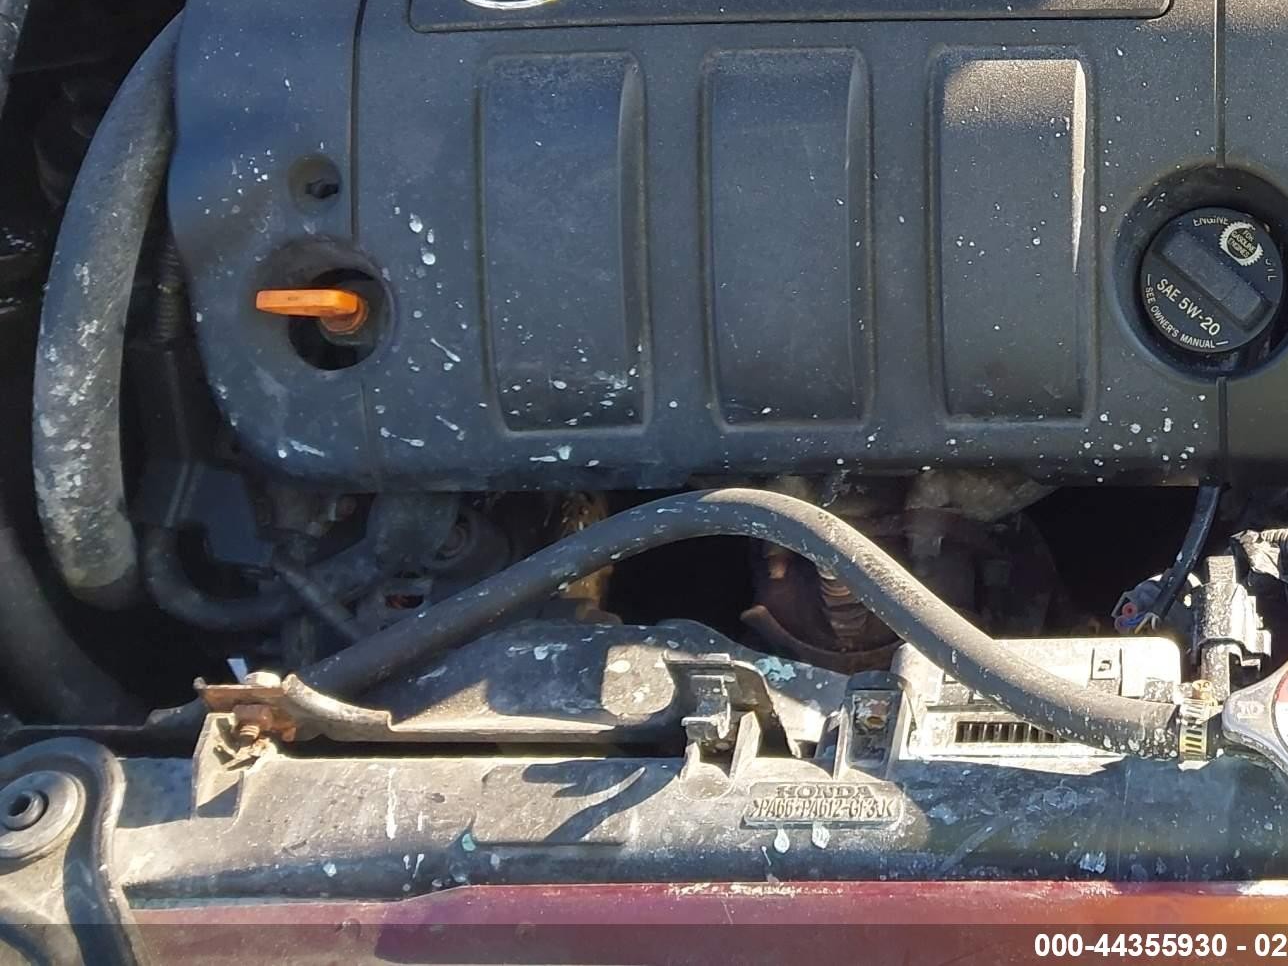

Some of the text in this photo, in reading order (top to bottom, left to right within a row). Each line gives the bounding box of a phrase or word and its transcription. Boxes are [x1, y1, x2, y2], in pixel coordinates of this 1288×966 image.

[1193, 215, 1229, 227] ENGINE
[1228, 237, 1250, 259] ENGINES
[1231, 231, 1256, 253] GASOLINE
[1145, 287, 1216, 349] SEE OWNER'S MANUAL
[1156, 279, 1221, 336] SAE 5W-20
[776, 785, 874, 798] HONDA
